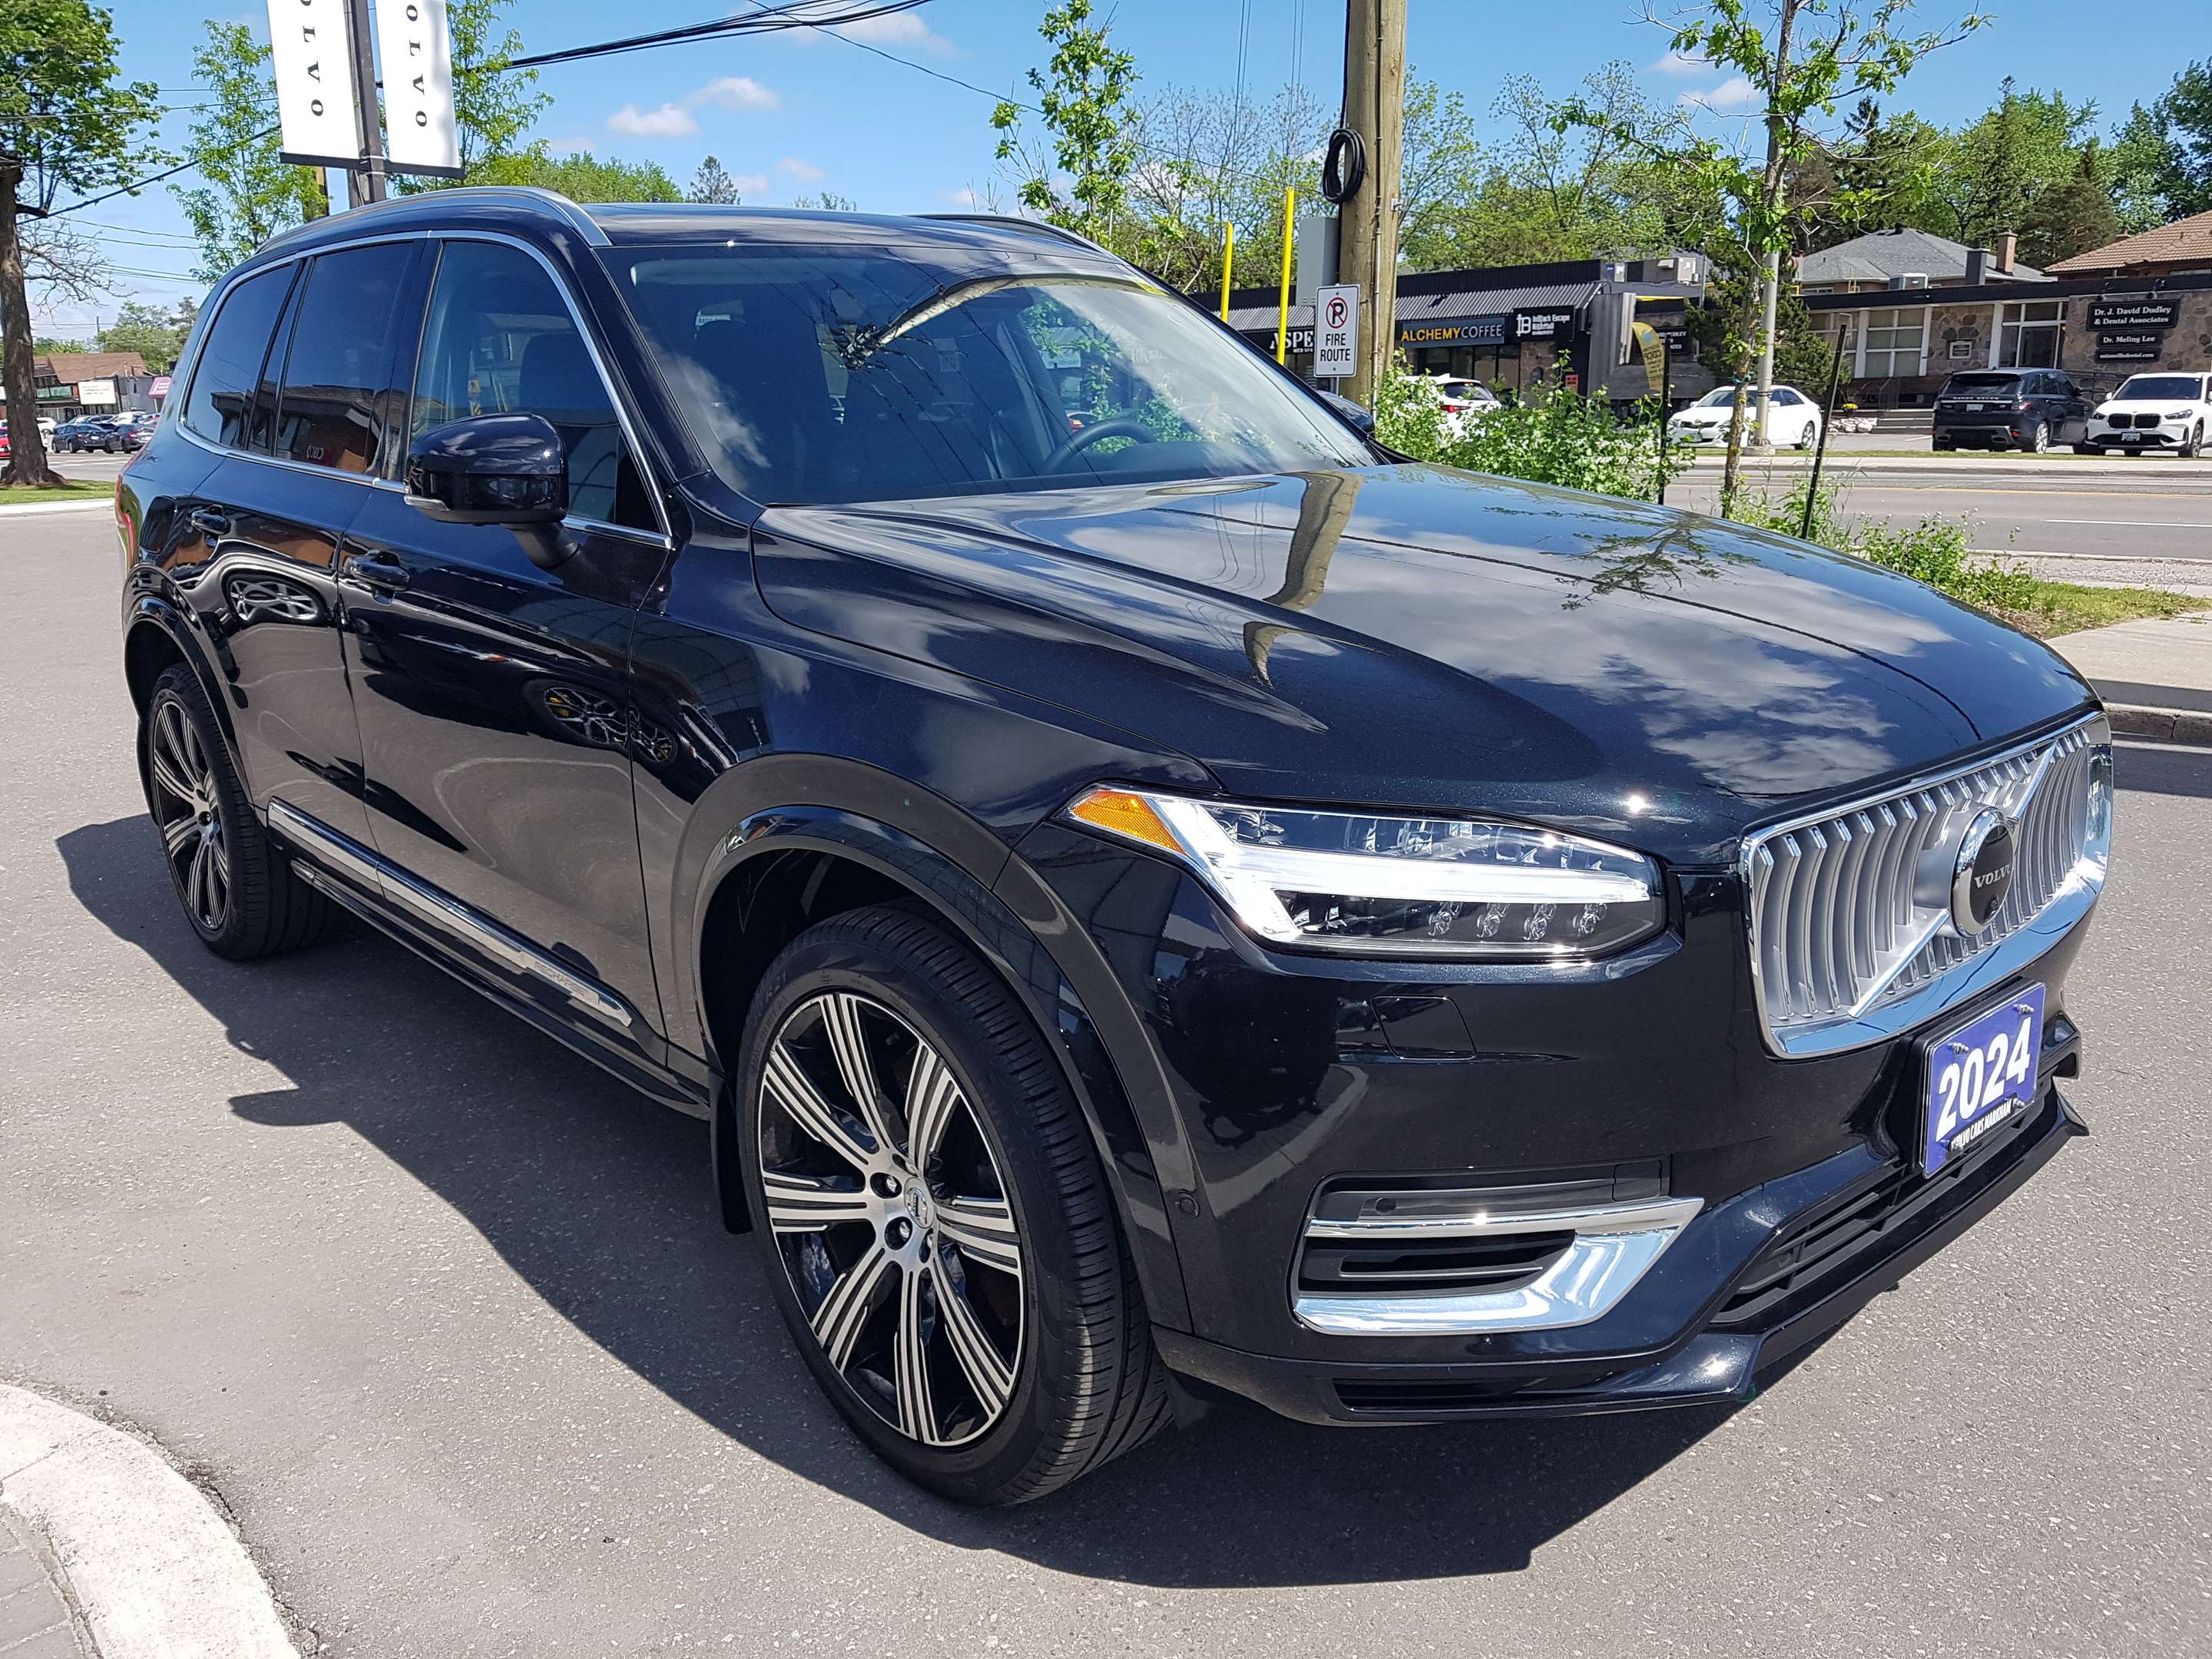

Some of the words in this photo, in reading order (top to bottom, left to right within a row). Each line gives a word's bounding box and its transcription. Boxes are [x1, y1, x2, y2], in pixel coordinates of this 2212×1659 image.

[2142, 306, 2172, 315] Dudley
[1325, 333, 1346, 346] FIRE
[1401, 327, 1461, 341] ALCHEMY
[1461, 324, 1502, 338] COFFEE
[1320, 348, 1351, 362] ROUTE
[1936, 1016, 2032, 1143] 2024
